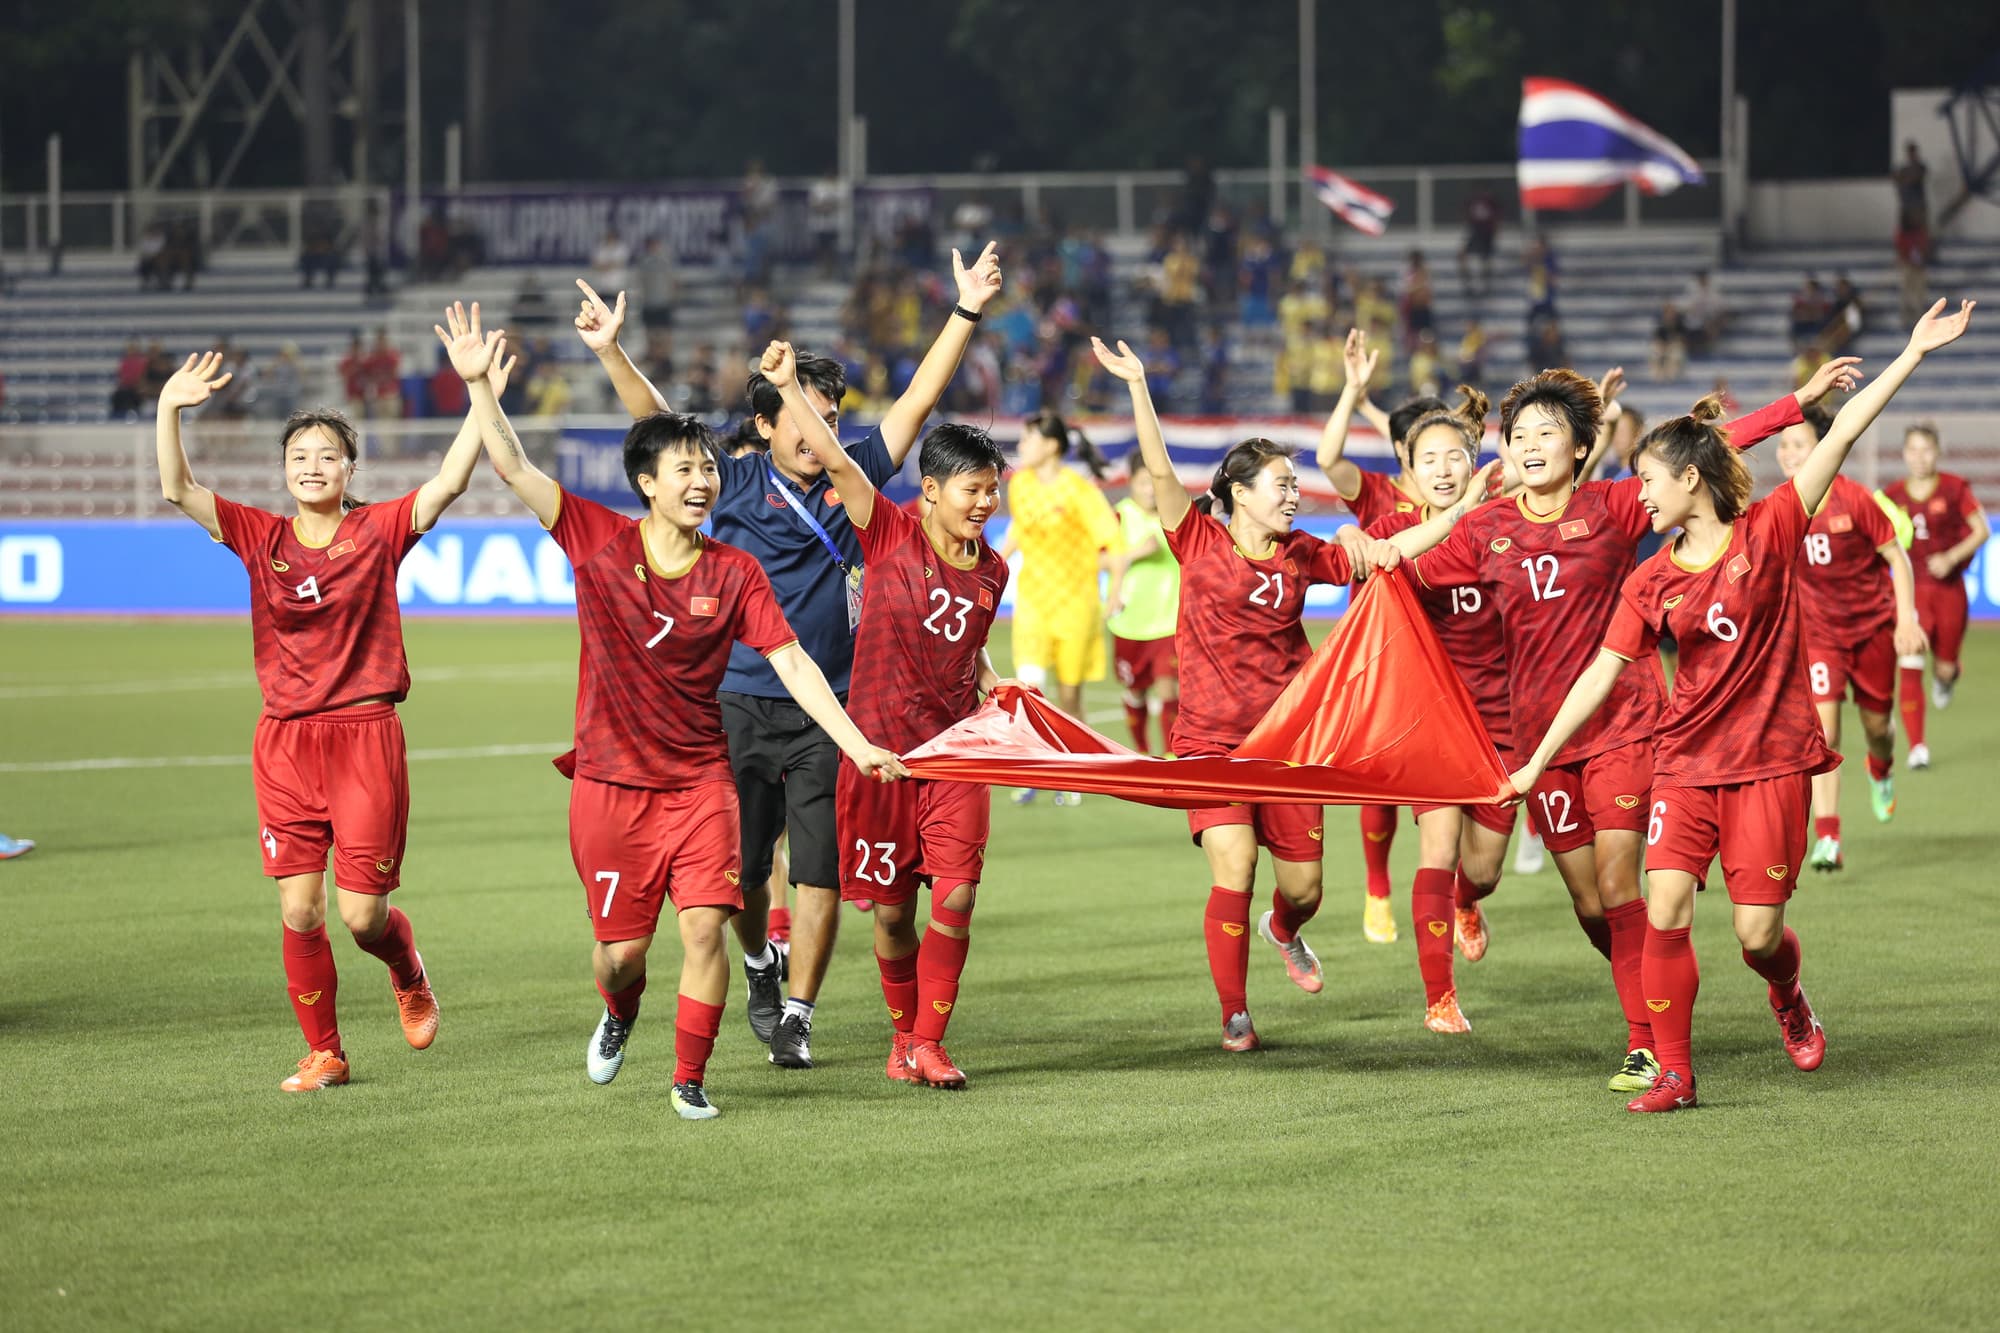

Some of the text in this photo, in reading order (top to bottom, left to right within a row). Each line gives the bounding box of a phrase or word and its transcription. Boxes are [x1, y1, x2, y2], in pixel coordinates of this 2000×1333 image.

[1803, 533, 1832, 566] 18
[295, 576, 321, 604] 4
[1249, 571, 1283, 609] 21
[1521, 554, 1566, 602] 12
[923, 587, 974, 642] 23
[1451, 586, 1481, 615] 15
[645, 610, 675, 648] 7
[1707, 602, 1738, 642] 6
[1810, 661, 1830, 695] 8
[1538, 790, 1579, 834] 12
[1647, 800, 1667, 846] 6
[262, 827, 277, 858] 4
[855, 838, 896, 886] 23
[595, 870, 620, 918] 7
